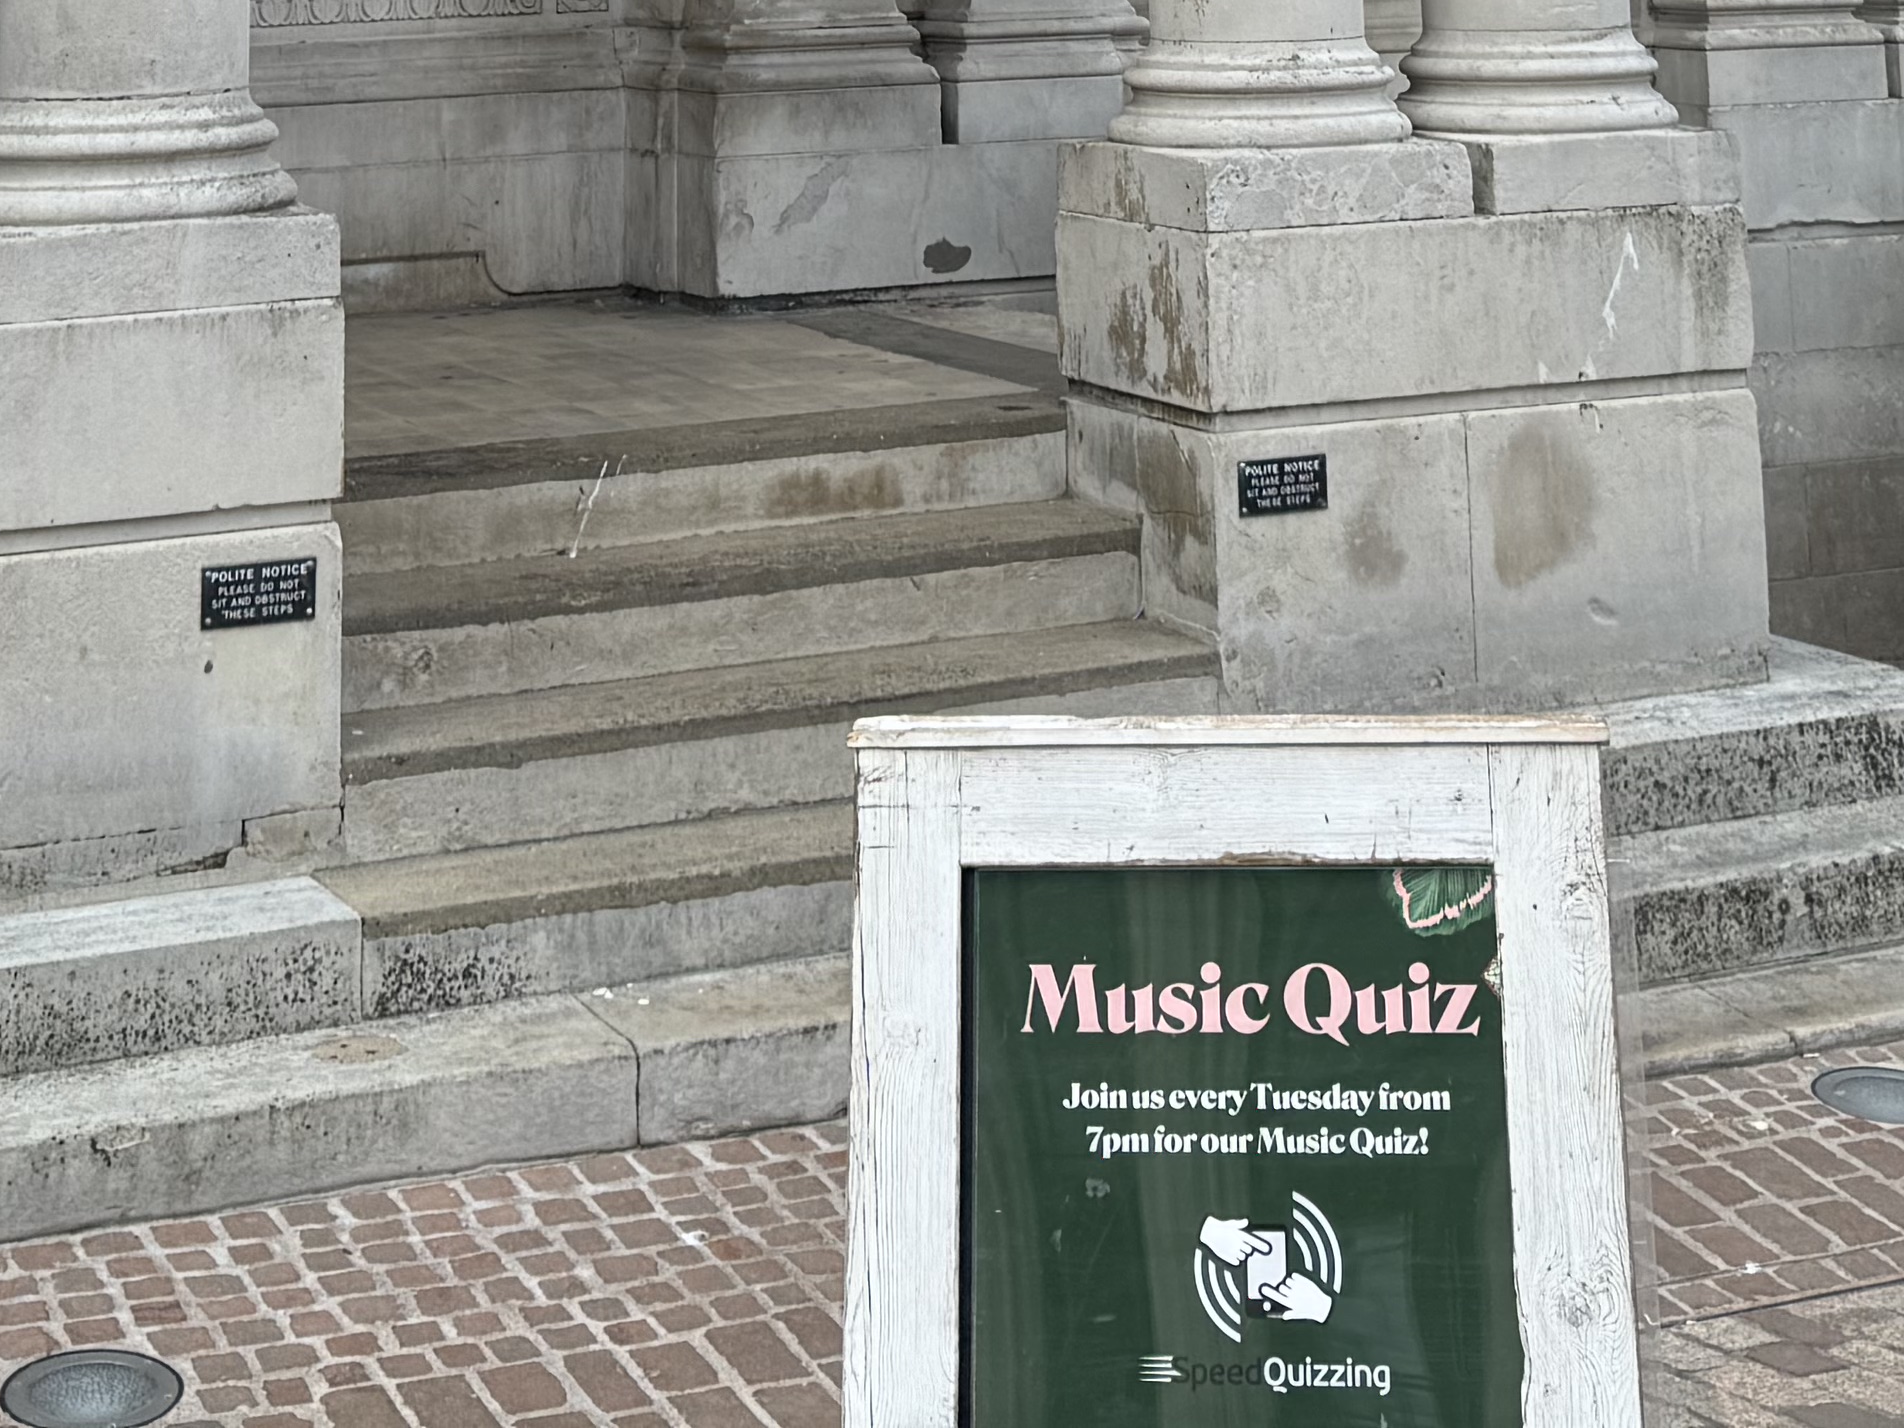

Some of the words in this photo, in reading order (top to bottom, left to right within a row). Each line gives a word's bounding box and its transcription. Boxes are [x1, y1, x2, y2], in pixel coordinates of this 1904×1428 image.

[211, 568, 255, 583] POLITE
[262, 563, 307, 578] NOTICE
[212, 598, 227, 609] SIT
[231, 597, 251, 607] AND
[255, 590, 306, 605] OBSTRUCT
[218, 584, 255, 597] PLEASE
[260, 582, 274, 592] DO
[280, 579, 299, 589] NOT
[222, 607, 255, 619] THESE
[262, 604, 293, 617] STEPS
[1020, 961, 1271, 1036] Music
[1283, 961, 1482, 1046] Quiz
[1062, 1081, 1129, 1111] Join
[1131, 1088, 1165, 1111] us
[1168, 1089, 1247, 1116] every
[1249, 1082, 1375, 1116] Tuesday
[1377, 1082, 1451, 1111] from
[1085, 1126, 1150, 1158] 7pm
[1153, 1125, 1198, 1154] for
[1200, 1131, 1254, 1154] our
[1257, 1126, 1345, 1155] Music
[1349, 1127, 1430, 1158] Quiz!
[1172, 1356, 1391, 1396] SpeedQuizzing
